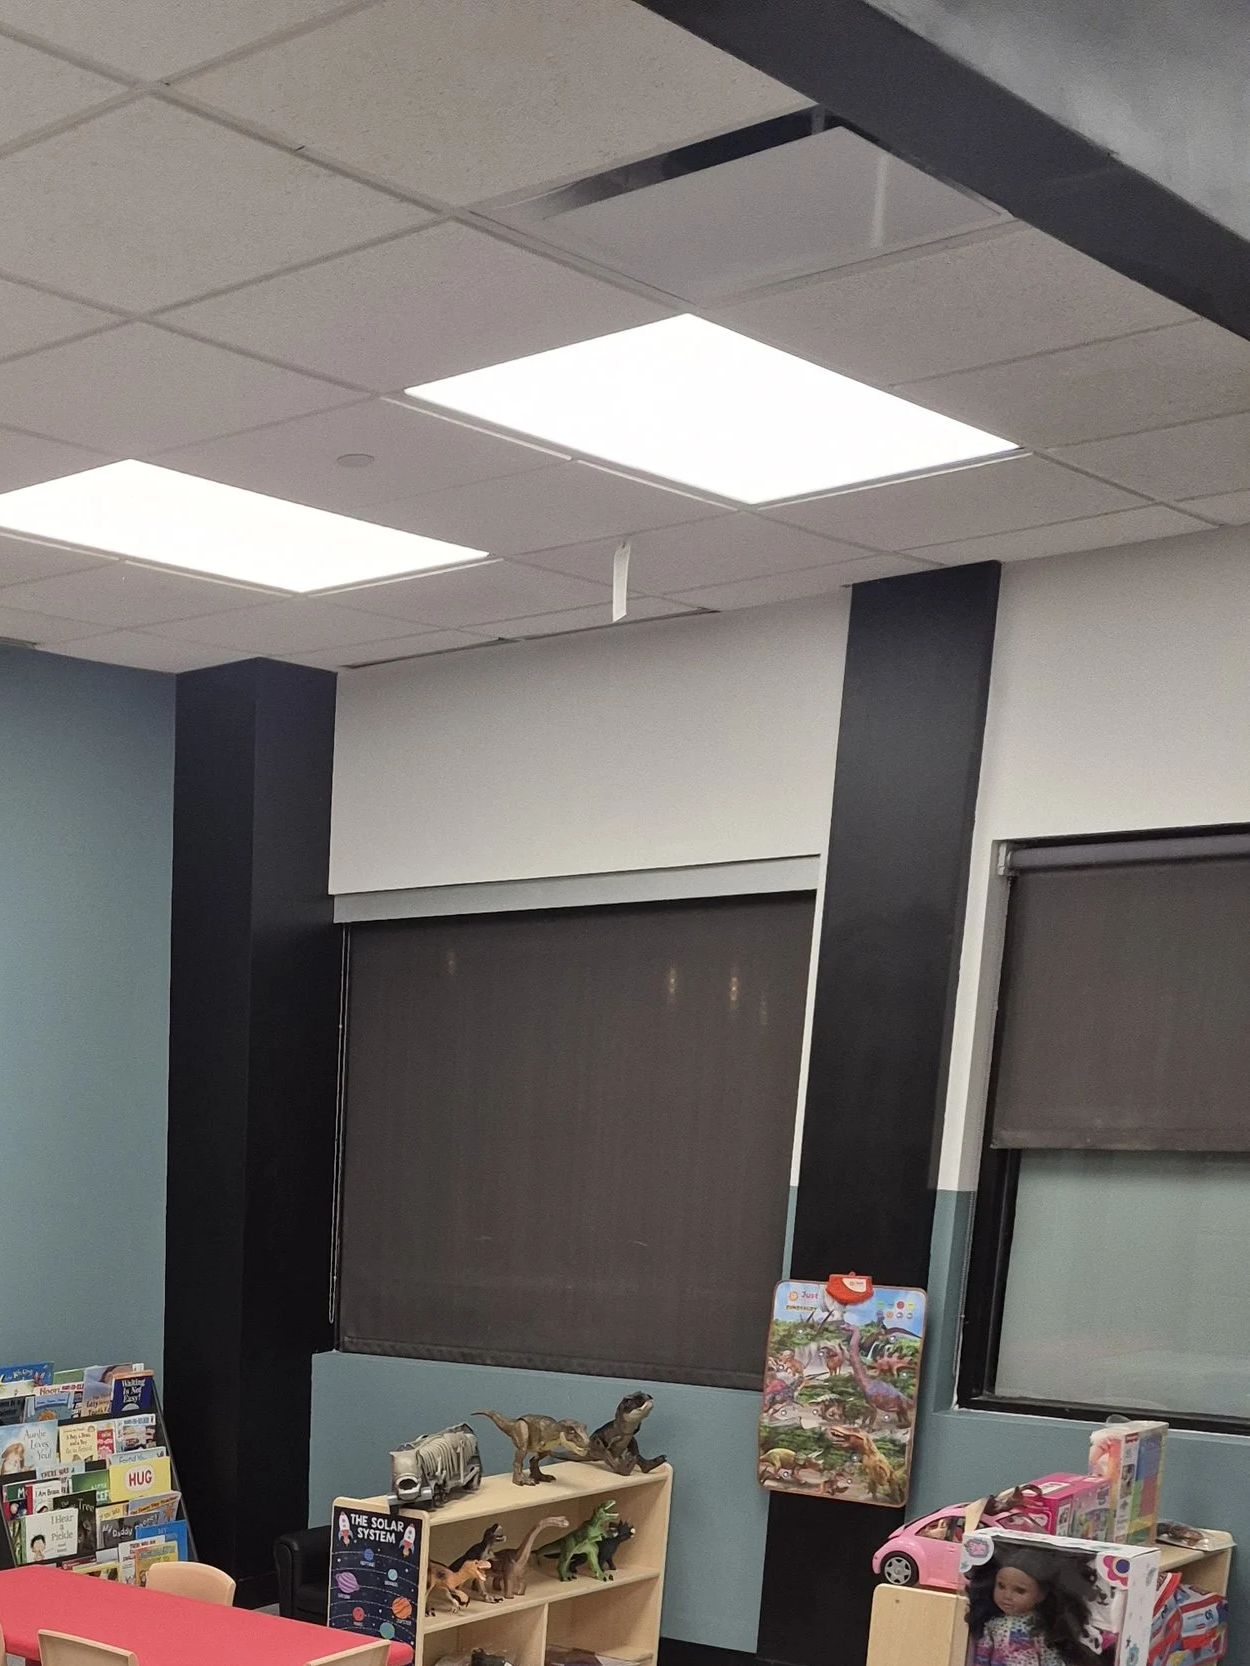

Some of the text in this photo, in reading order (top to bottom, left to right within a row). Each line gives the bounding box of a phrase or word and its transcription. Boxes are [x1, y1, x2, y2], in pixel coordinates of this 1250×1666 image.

[121, 1379, 146, 1388] Waiting
[131, 1385, 142, 1394] Not
[123, 1393, 141, 1403] Easy!
[24, 1429, 47, 1440] Auntie
[30, 1440, 49, 1449] Loves
[37, 1448, 52, 1460] You!
[128, 1469, 152, 1487] HUG
[78, 1498, 94, 1512] Tree
[55, 1514, 74, 1523] Hear
[350, 1513, 405, 1533] THE SOLAR
[51, 1530, 74, 1542] Pickle
[102, 1524, 133, 1537] My Daddy
[357, 1527, 396, 1544] SYSTEM
